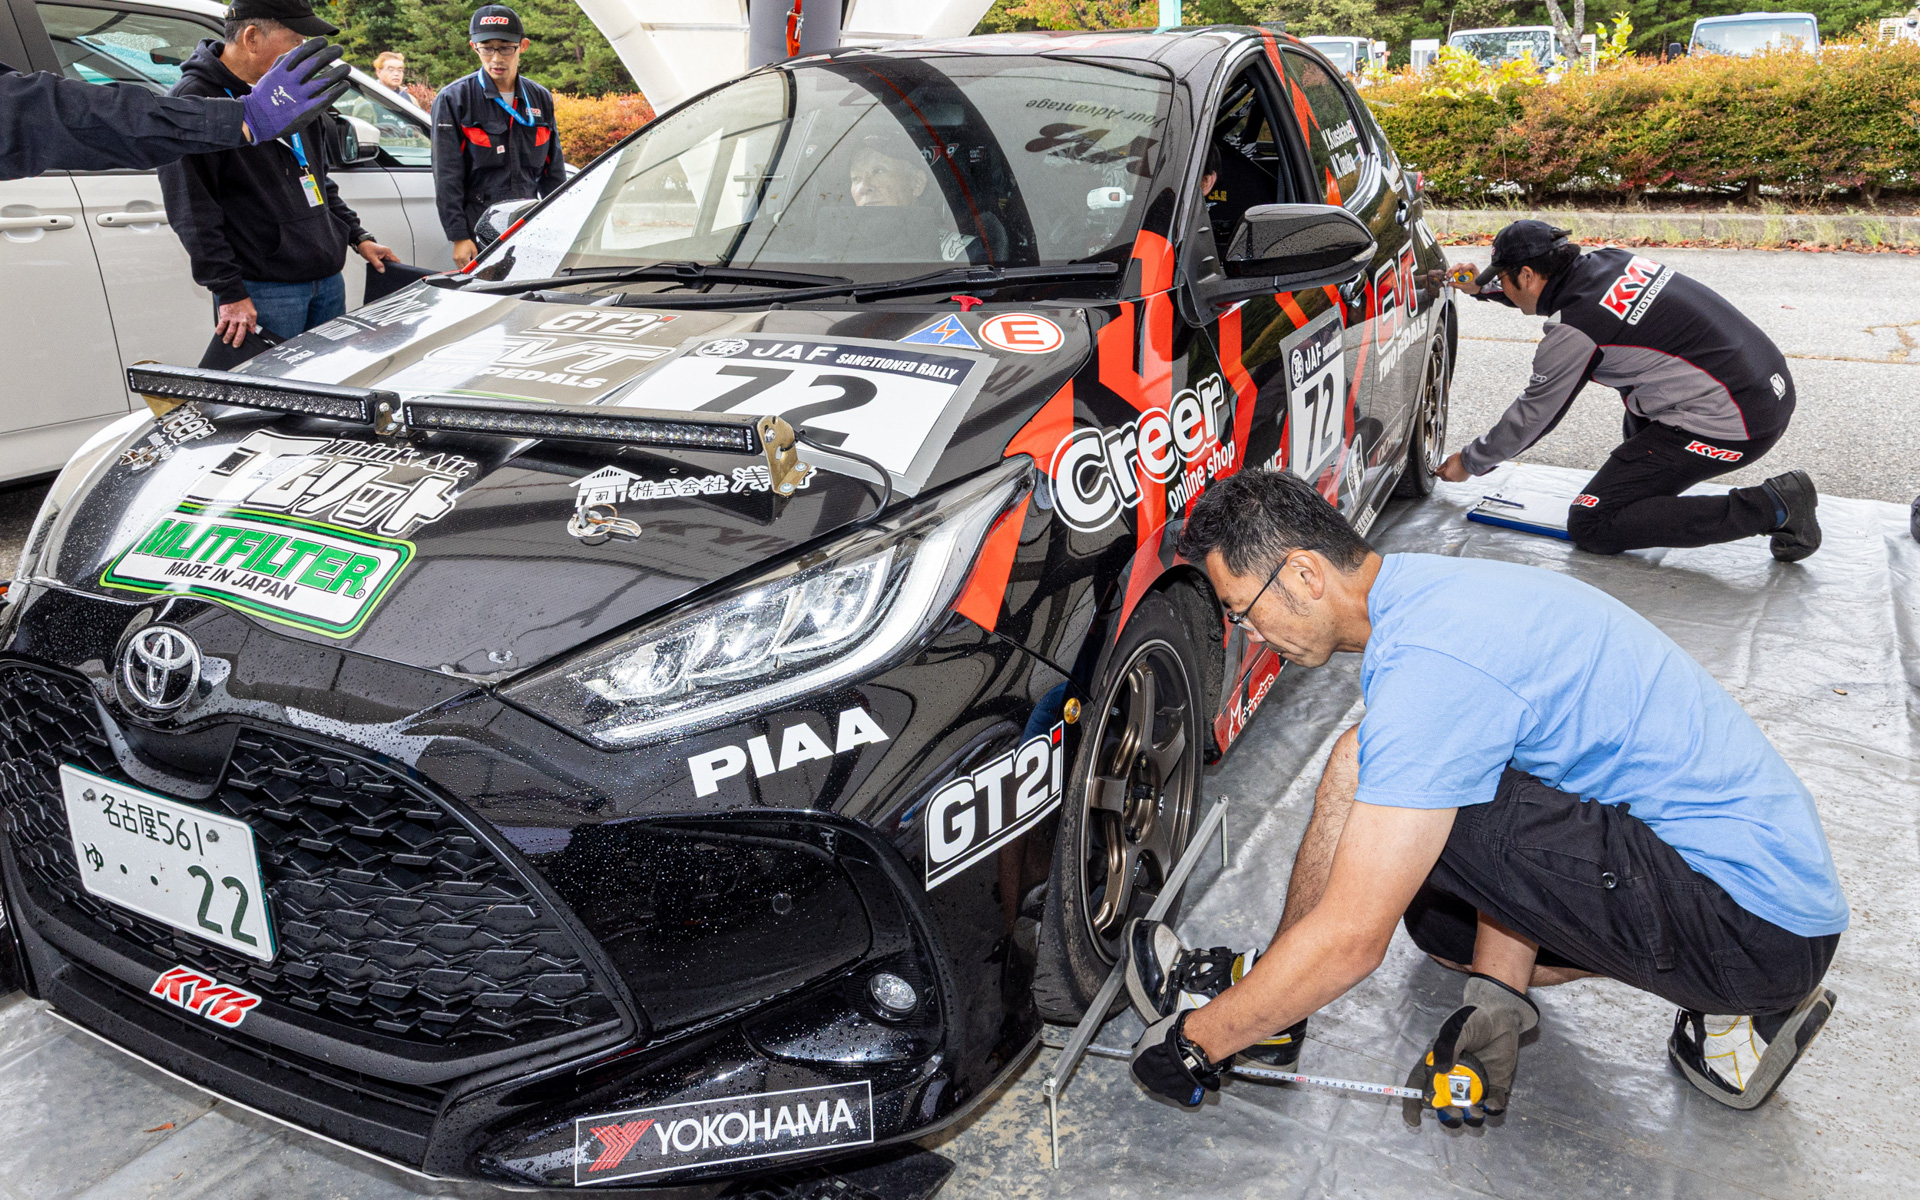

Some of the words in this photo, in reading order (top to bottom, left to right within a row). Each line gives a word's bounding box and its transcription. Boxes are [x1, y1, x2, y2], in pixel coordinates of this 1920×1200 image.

[480, 16, 508, 25] KYB
[1026, 98, 1125, 120] Advantage
[520, 310, 682, 339] GT2i
[1001, 321, 1041, 344] E
[752, 344, 837, 361] JAF
[835, 353, 918, 374] SANCTIONED
[916, 363, 959, 380] RALLY
[1305, 341, 1321, 374] JAF
[475, 367, 609, 390] PEDALS
[692, 364, 878, 448] 72
[1305, 372, 1334, 474] 72
[324, 438, 420, 467] Think
[1049, 372, 1225, 532] Creer
[1685, 440, 1743, 462] KYB
[630, 474, 729, 500] 株式会社
[731, 465, 818, 494] 浅
[1168, 464, 1206, 513] online
[1206, 440, 1236, 480] shop
[133, 518, 381, 598] MLITFILTER
[165, 561, 211, 580] MADE
[212, 569, 231, 585] IN
[232, 573, 298, 601] JAPAN
[688, 706, 890, 798] PIAA
[926, 722, 1064, 868] GT2i
[82, 842, 105, 872] ゆ
[149, 964, 262, 1028] KYB
[653, 1098, 856, 1156] YOKOHAMA
